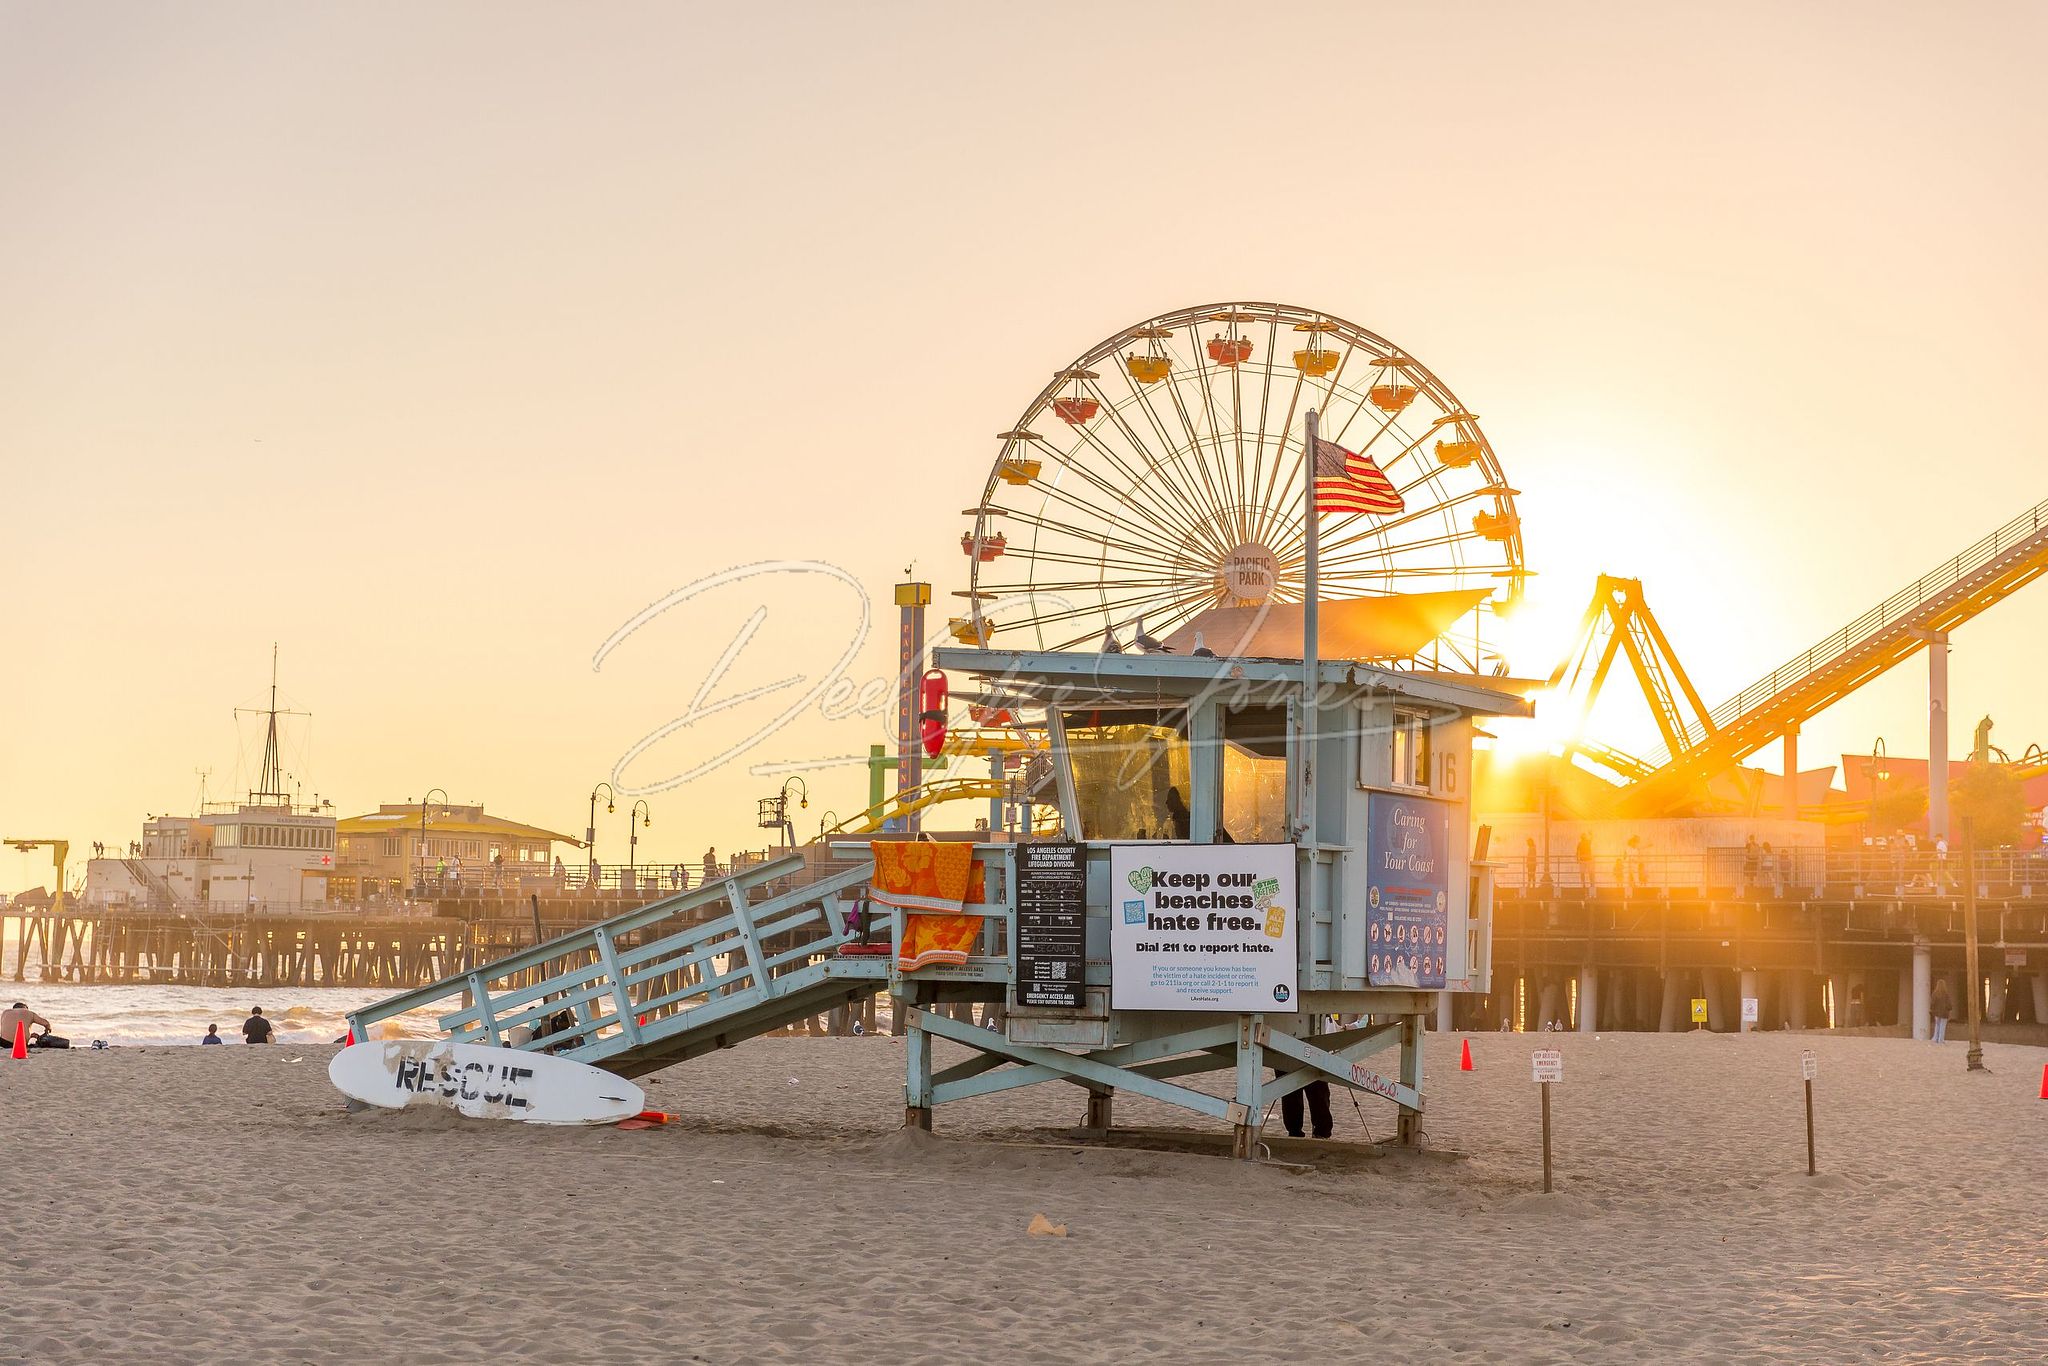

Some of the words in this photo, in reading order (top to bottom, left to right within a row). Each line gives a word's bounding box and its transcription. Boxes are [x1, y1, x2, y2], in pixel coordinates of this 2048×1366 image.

[1234, 556, 1270, 570] PACIFIC
[1240, 572, 1264, 586] PARK
[901, 624, 910, 716] PACIFIC
[1439, 751, 1456, 793] 16
[1394, 808, 1426, 834] Caring
[1401, 832, 1418, 854] for
[1384, 852, 1406, 870] Your
[1408, 854, 1434, 873] Coast
[1152, 871, 1210, 891] Keep
[1217, 872, 1256, 887] our
[1155, 892, 1254, 908] beaches
[1148, 913, 1200, 930] hate
[1207, 913, 1261, 930] free.
[1136, 943, 1159, 952] Dial
[1162, 943, 1180, 952] 211
[1183, 943, 1196, 952] to
[1200, 944, 1239, 954] report
[1242, 943, 1274, 952] hate.
[396, 1056, 534, 1107] RESCUE
